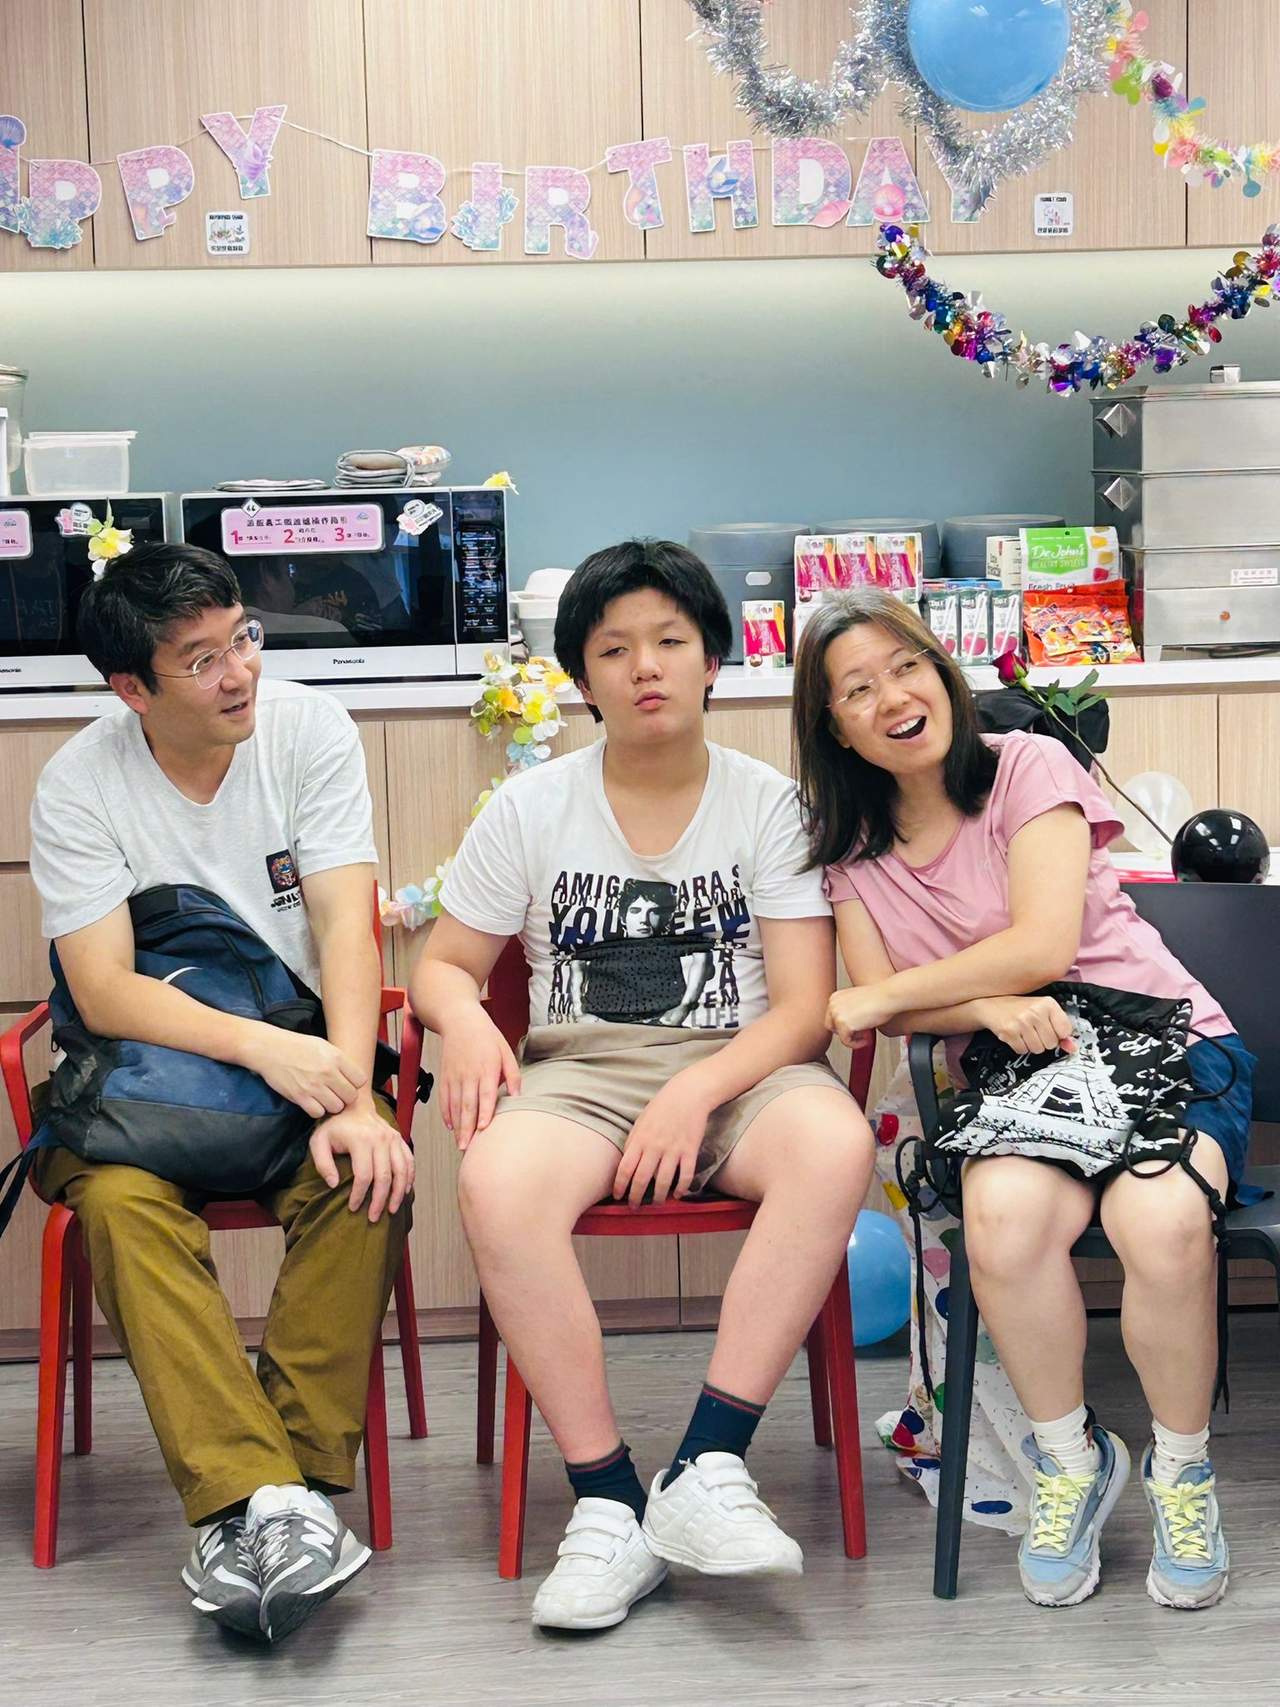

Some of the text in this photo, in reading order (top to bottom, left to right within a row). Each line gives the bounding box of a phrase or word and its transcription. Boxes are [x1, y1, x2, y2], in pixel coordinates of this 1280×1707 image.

[231, 530, 239, 544] 1
[284, 529, 295, 543] 2
[335, 527, 345, 542] 3
[552, 871, 621, 898] AMIG
